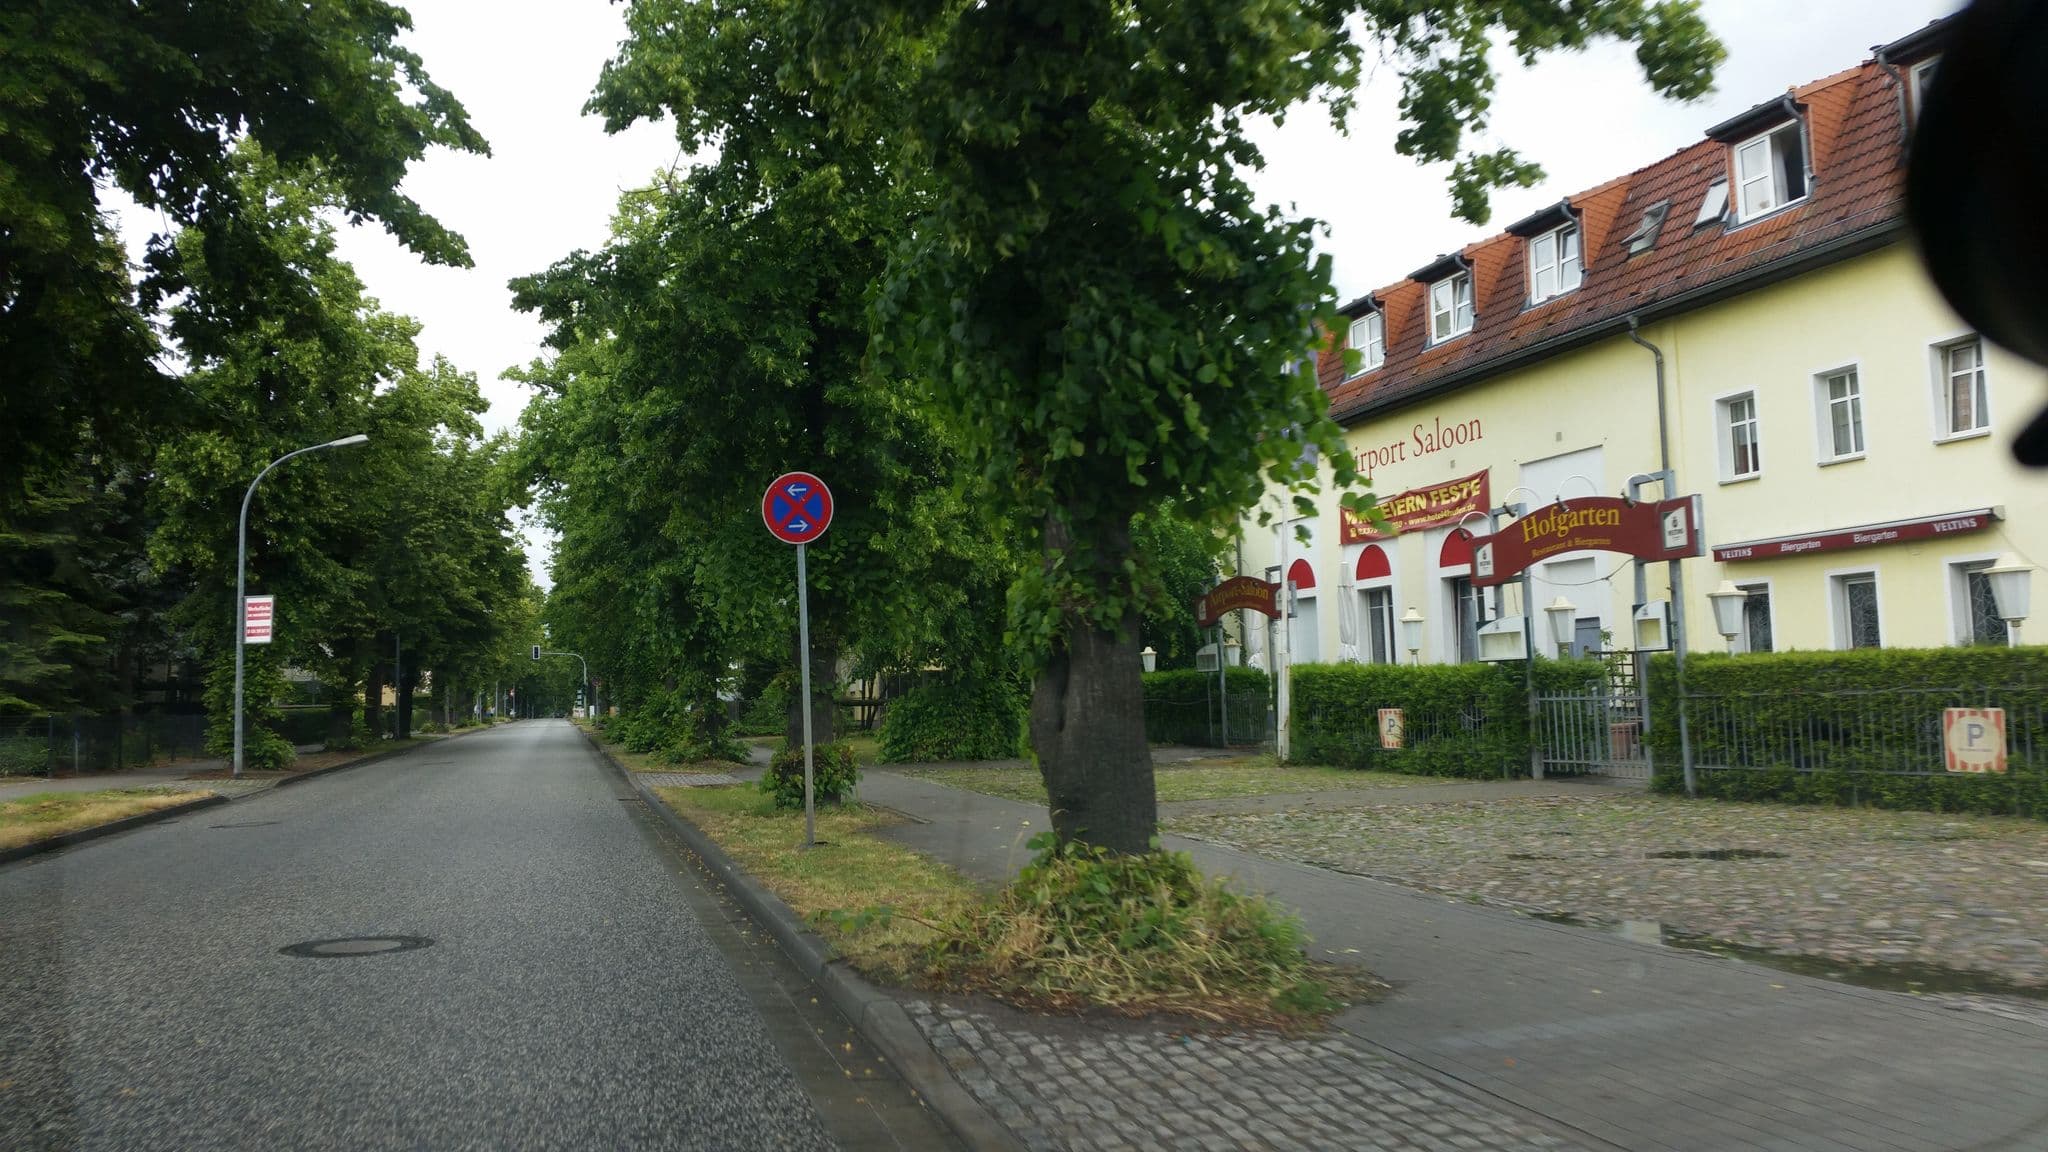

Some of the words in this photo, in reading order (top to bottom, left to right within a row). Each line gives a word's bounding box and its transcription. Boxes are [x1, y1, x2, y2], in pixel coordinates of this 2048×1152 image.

[1354, 440, 1406, 481] irport
[1413, 416, 1483, 457] Saloon
[1431, 478, 1481, 507] FESTE
[1521, 505, 1621, 543] Hofgarten
[1720, 547, 1752, 559] VELTINS
[1781, 540, 1821, 552] Biergarten
[1853, 530, 1898, 543] Biergarten
[1932, 518, 1977, 533] VELTINS
[1967, 723, 1984, 747] P
